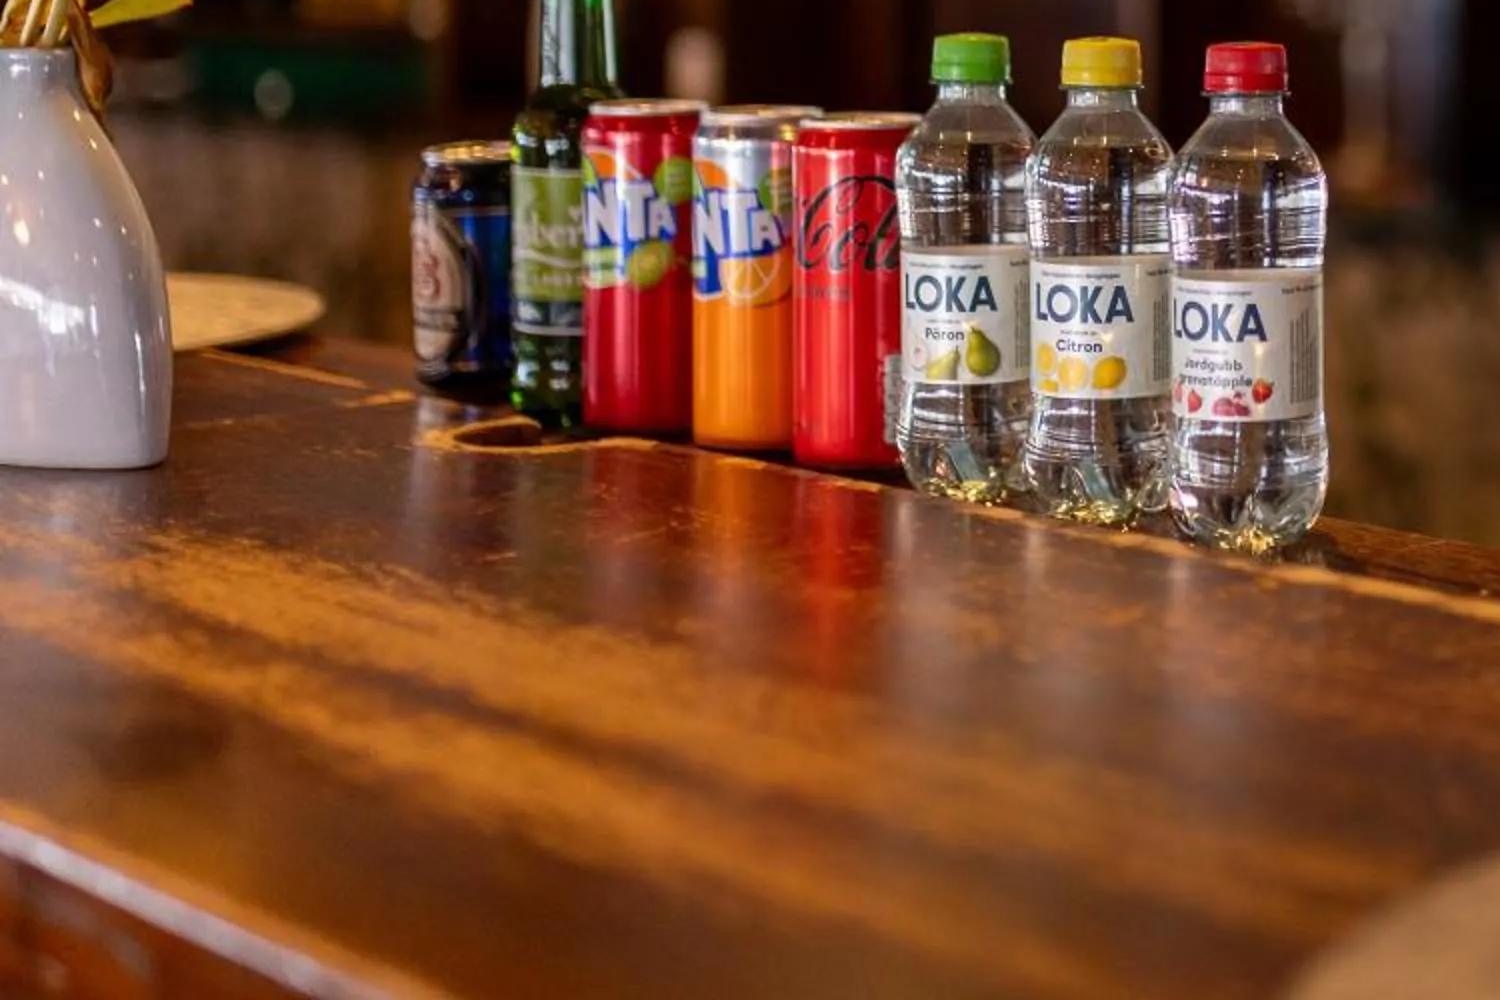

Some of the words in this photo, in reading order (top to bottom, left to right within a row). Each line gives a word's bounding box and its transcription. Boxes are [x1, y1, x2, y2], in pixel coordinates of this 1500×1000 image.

[905, 273, 998, 312] LOKA
[1036, 282, 1135, 324] LOKA
[1173, 297, 1268, 343] LOKA
[1056, 338, 1103, 353] Citron
